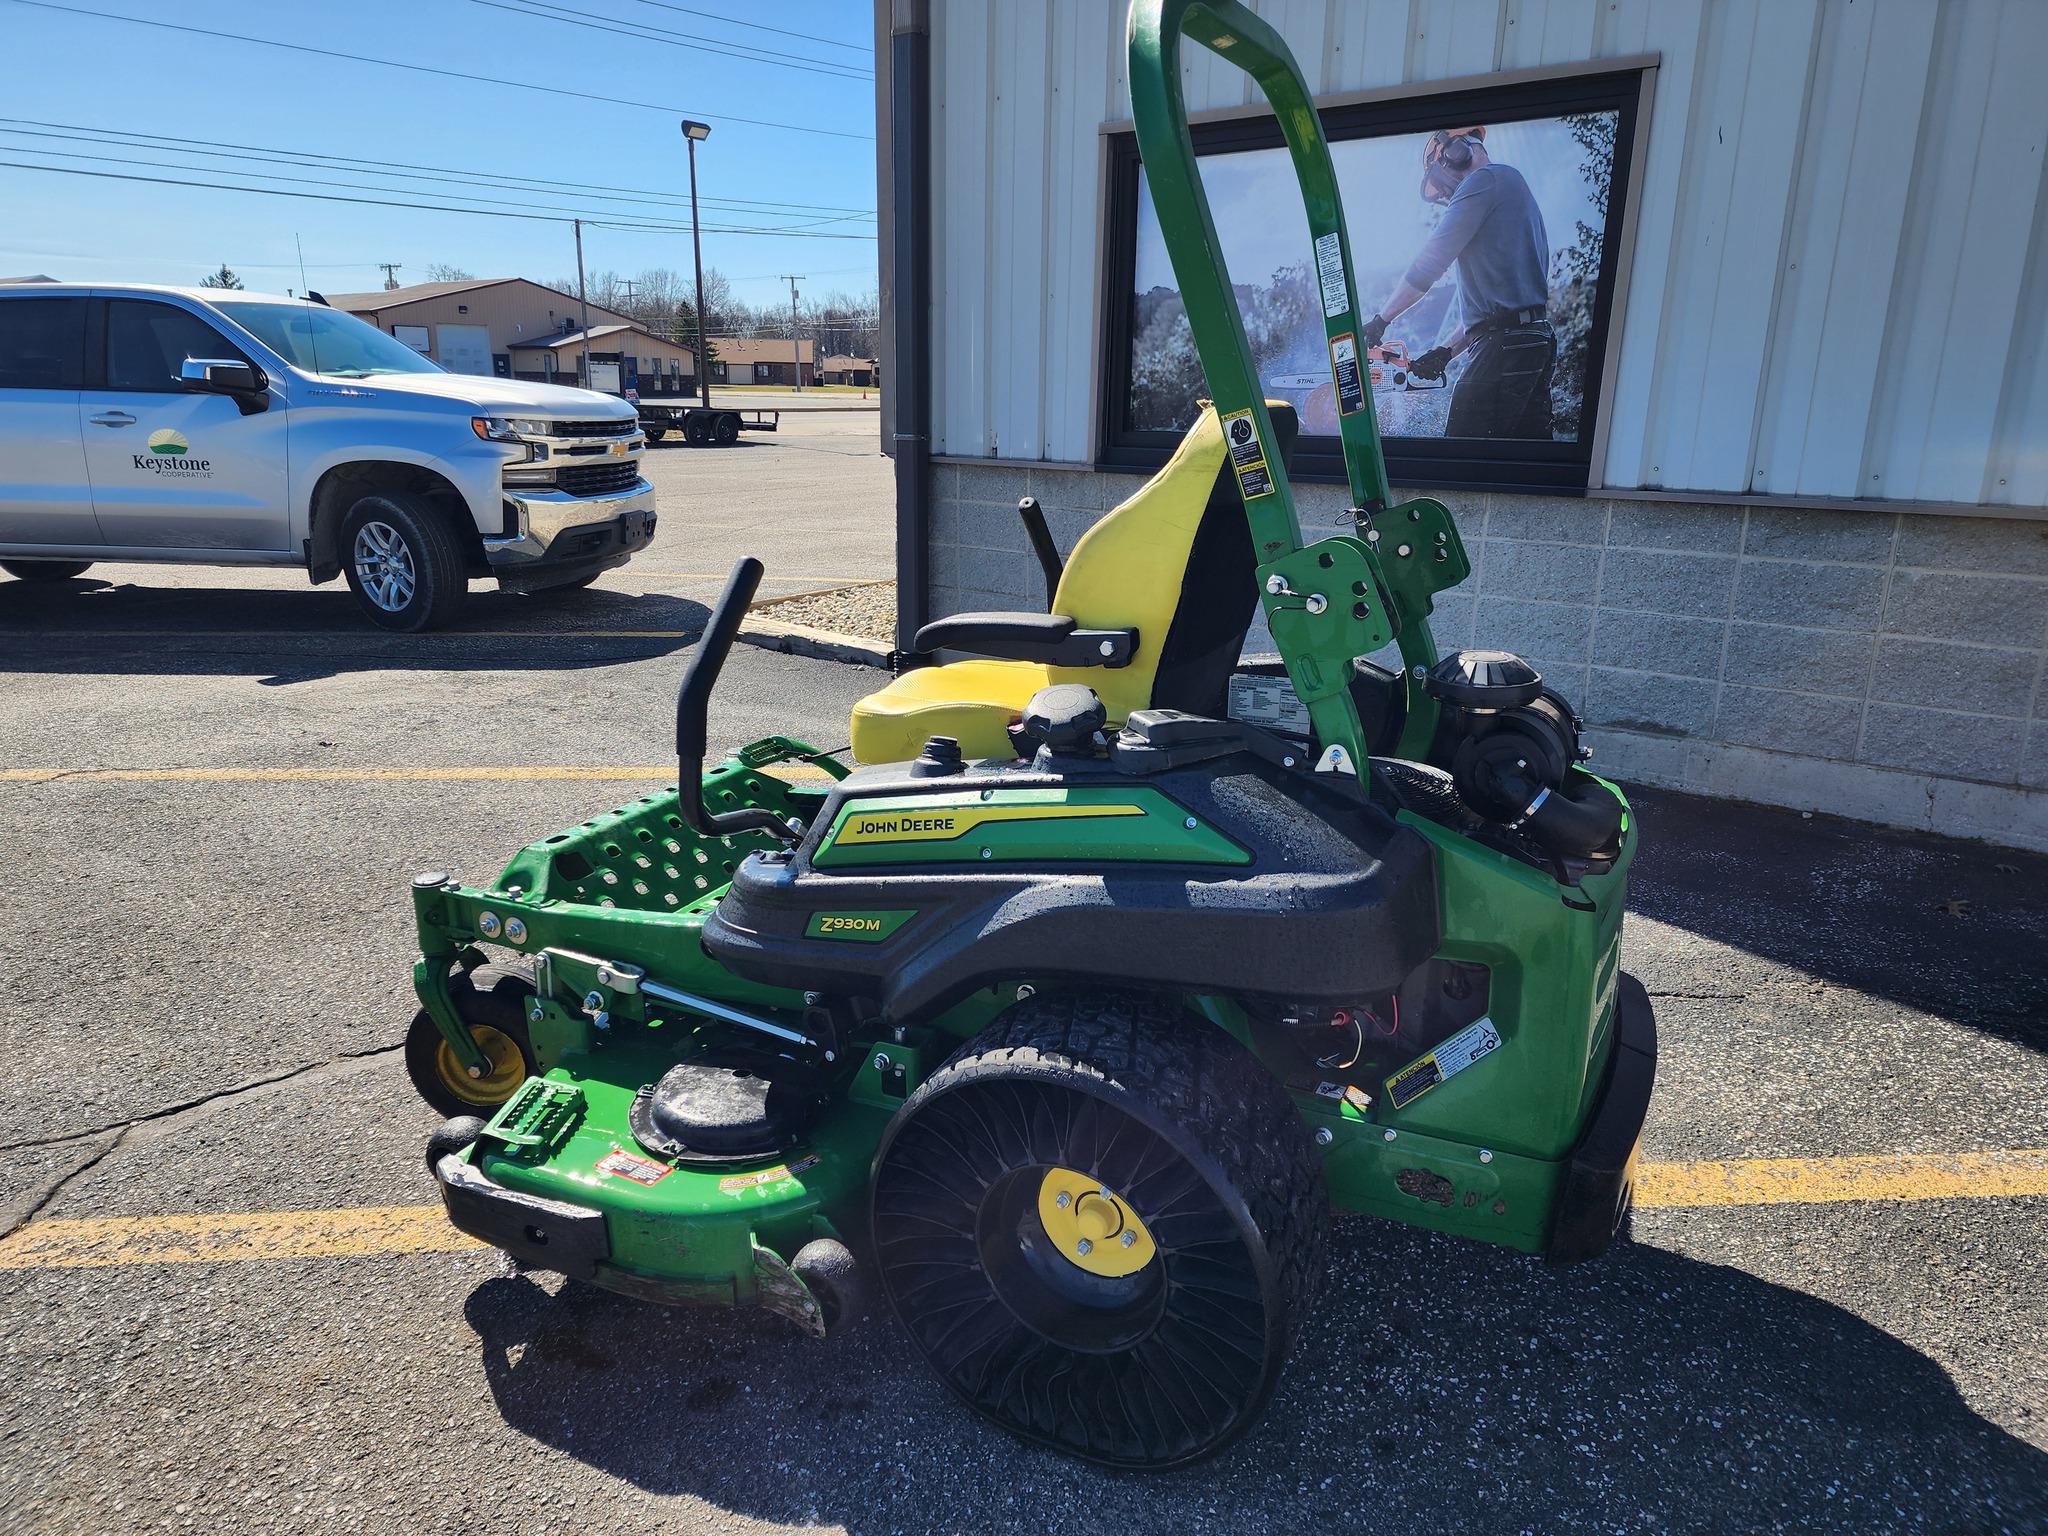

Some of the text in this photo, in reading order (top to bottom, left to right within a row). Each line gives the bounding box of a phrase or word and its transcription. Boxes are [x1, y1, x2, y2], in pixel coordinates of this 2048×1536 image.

[1227, 409, 1249, 420] CAUTION
[132, 454, 211, 474] Keystone
[856, 818, 955, 834] JOHN DEERE
[820, 917, 881, 932] Z930M
[1400, 1060, 1426, 1080] ATENCIÓN
